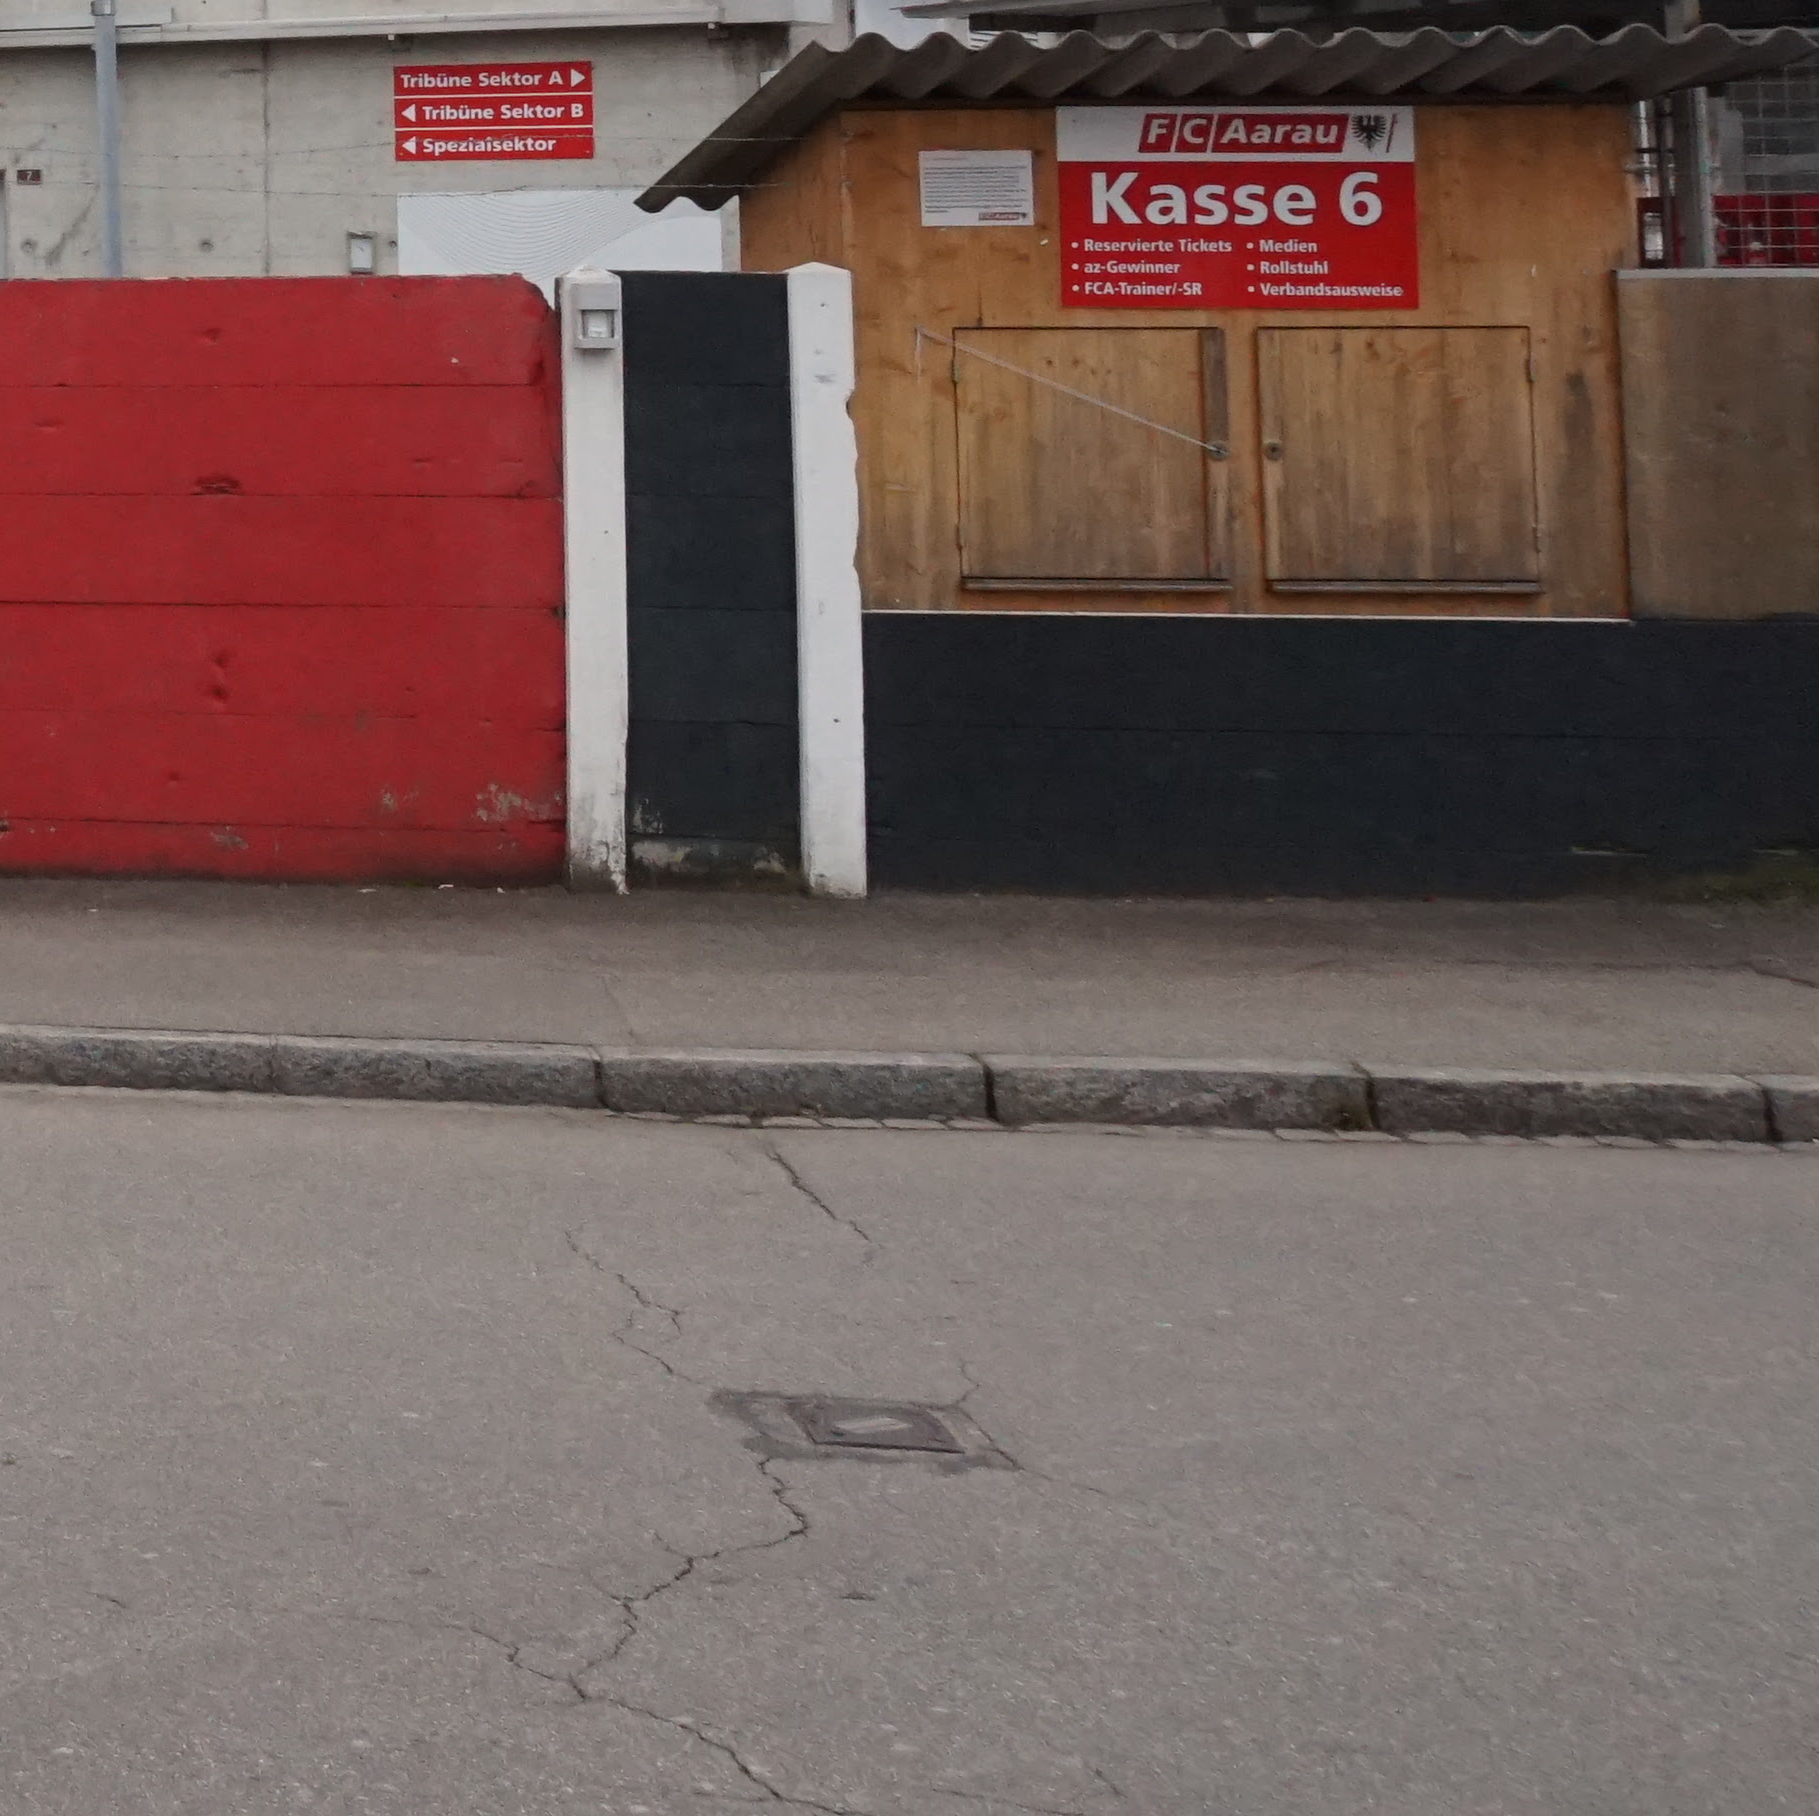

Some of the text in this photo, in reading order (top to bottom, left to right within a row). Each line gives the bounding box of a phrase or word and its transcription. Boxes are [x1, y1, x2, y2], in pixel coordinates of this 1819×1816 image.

[401, 71, 563, 88] Tribüne Sektor A
[422, 103, 583, 120] Tribüne Sektor B
[422, 136, 557, 156] Spezialsektor
[1091, 172, 1317, 225] Kasse
[1339, 172, 1383, 226] 6
[1084, 239, 1232, 252] Reservierte Tickets
[1259, 239, 1317, 252] Medien
[1084, 261, 1180, 273] az-Gewinner
[1260, 261, 1328, 274] Rollstuhl
[1084, 281, 1202, 296] FCA-Trainer/-SR
[1260, 282, 1403, 297] Verbandsausweise
